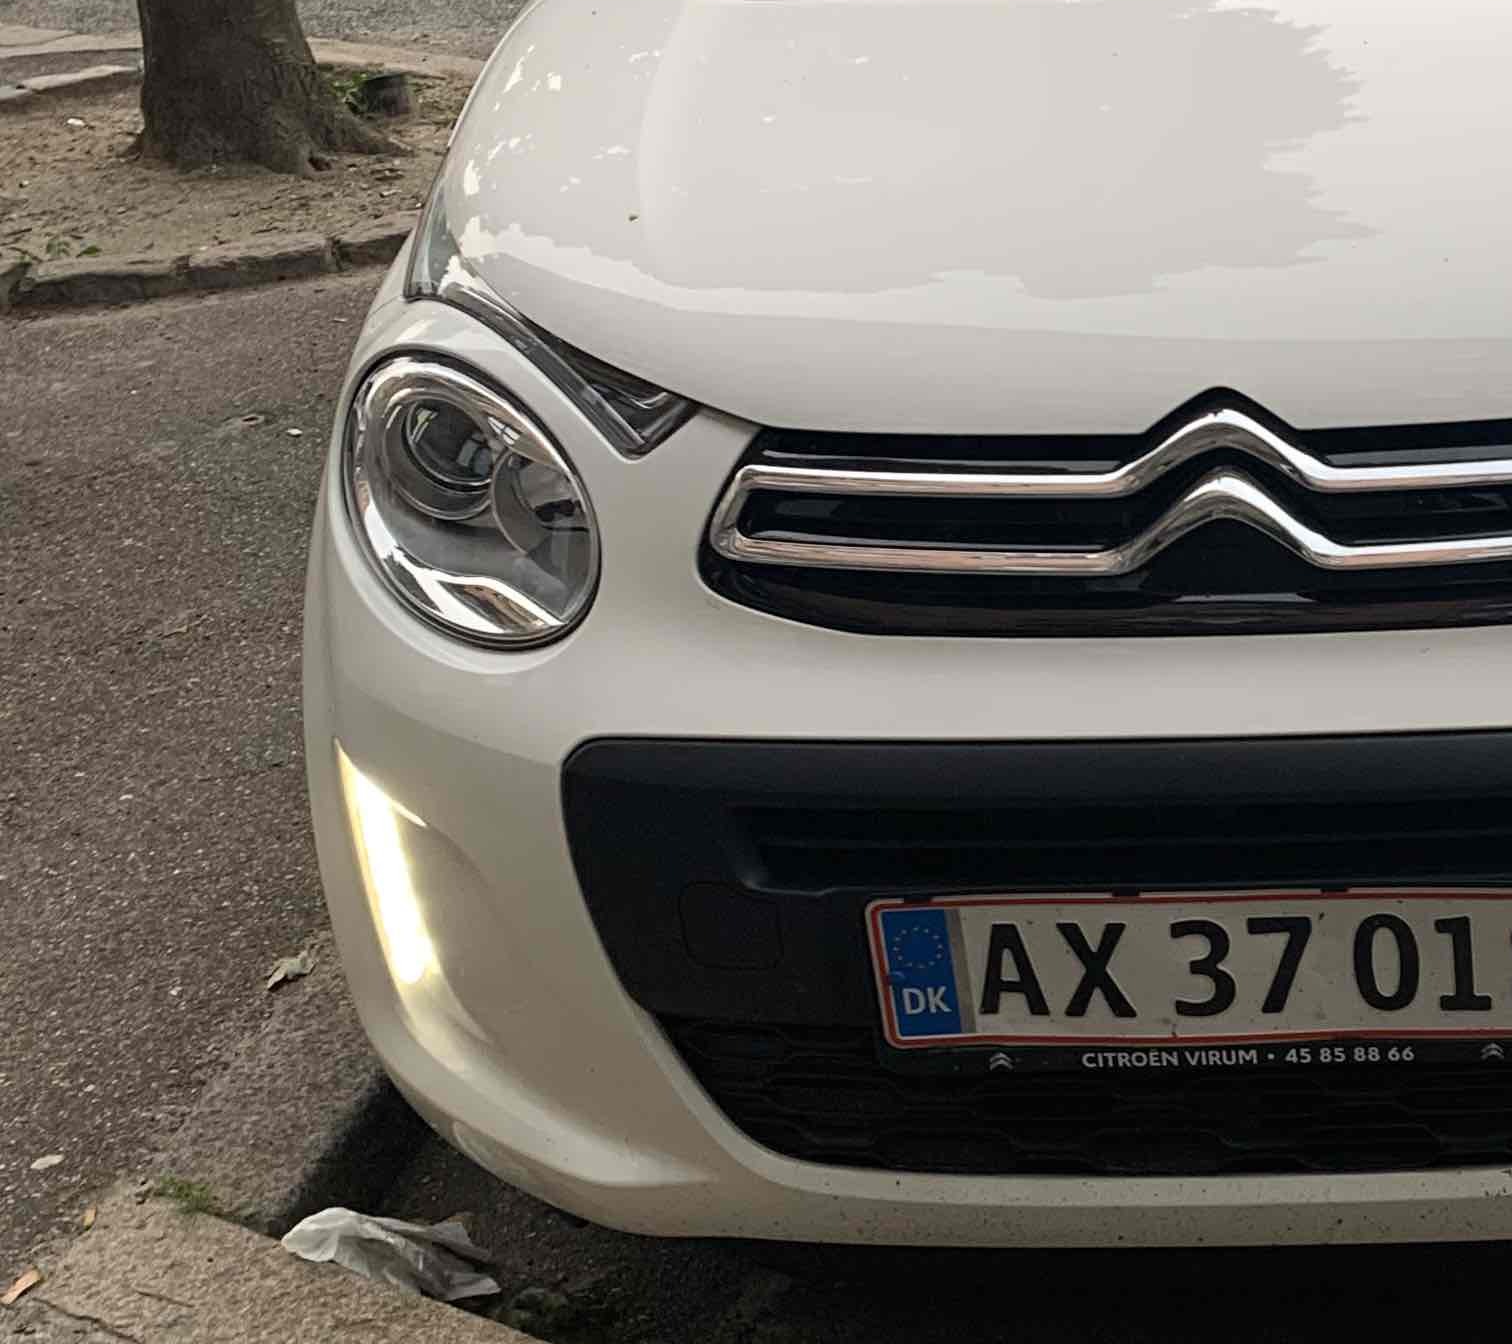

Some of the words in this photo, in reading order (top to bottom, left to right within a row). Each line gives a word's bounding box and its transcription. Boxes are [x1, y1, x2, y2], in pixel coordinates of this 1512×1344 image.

[979, 922, 1137, 1018] AX
[1170, 915, 1312, 1016] 37
[902, 986, 953, 1015] DK
[1185, 1049, 1258, 1066] VIRUM
[1285, 1047, 1311, 1064] 45
[1320, 1047, 1346, 1063] 85
[1354, 1046, 1380, 1062] 88
[1388, 1046, 1415, 1062] 66
